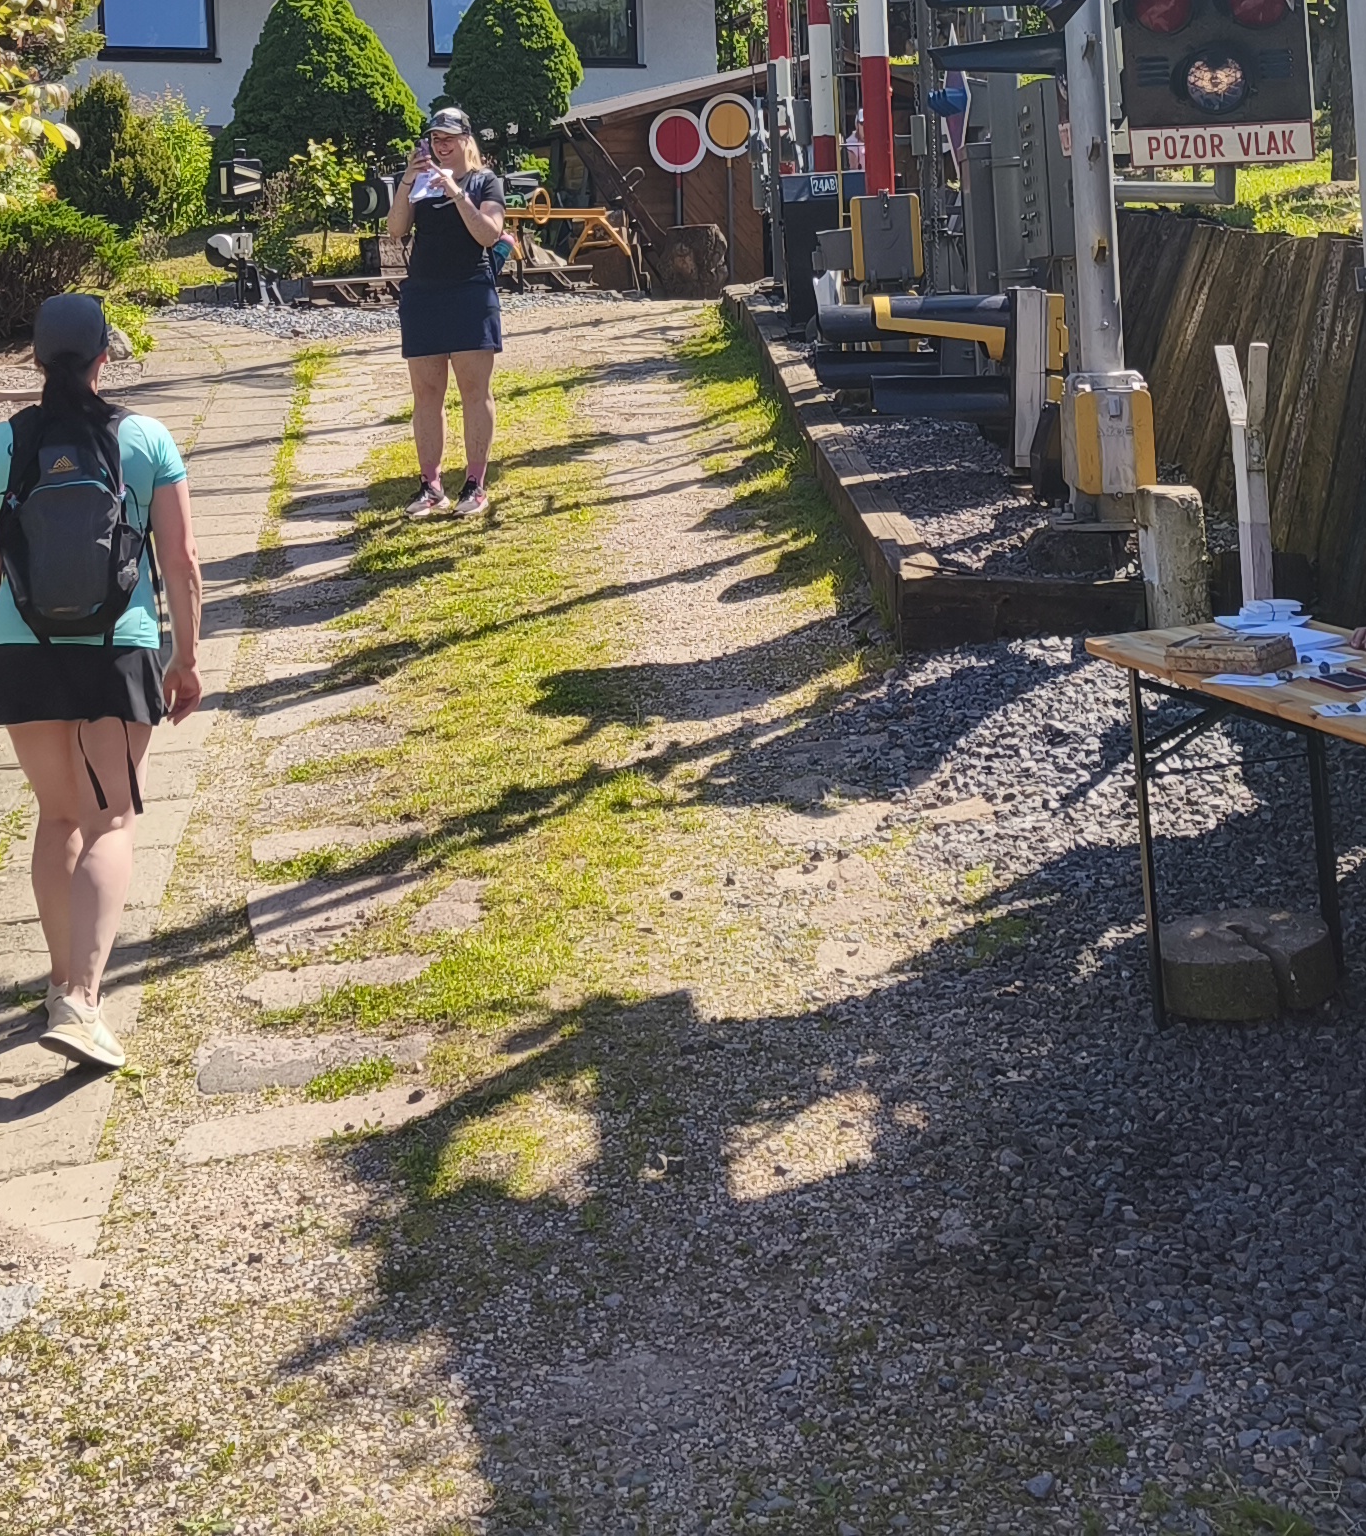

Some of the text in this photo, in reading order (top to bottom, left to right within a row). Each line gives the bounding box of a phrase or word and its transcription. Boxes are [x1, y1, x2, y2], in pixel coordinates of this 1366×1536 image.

[1148, 130, 1296, 160] POZOR VLAK
[812, 178, 836, 192] 24AB
[235, 236, 241, 250] 1
